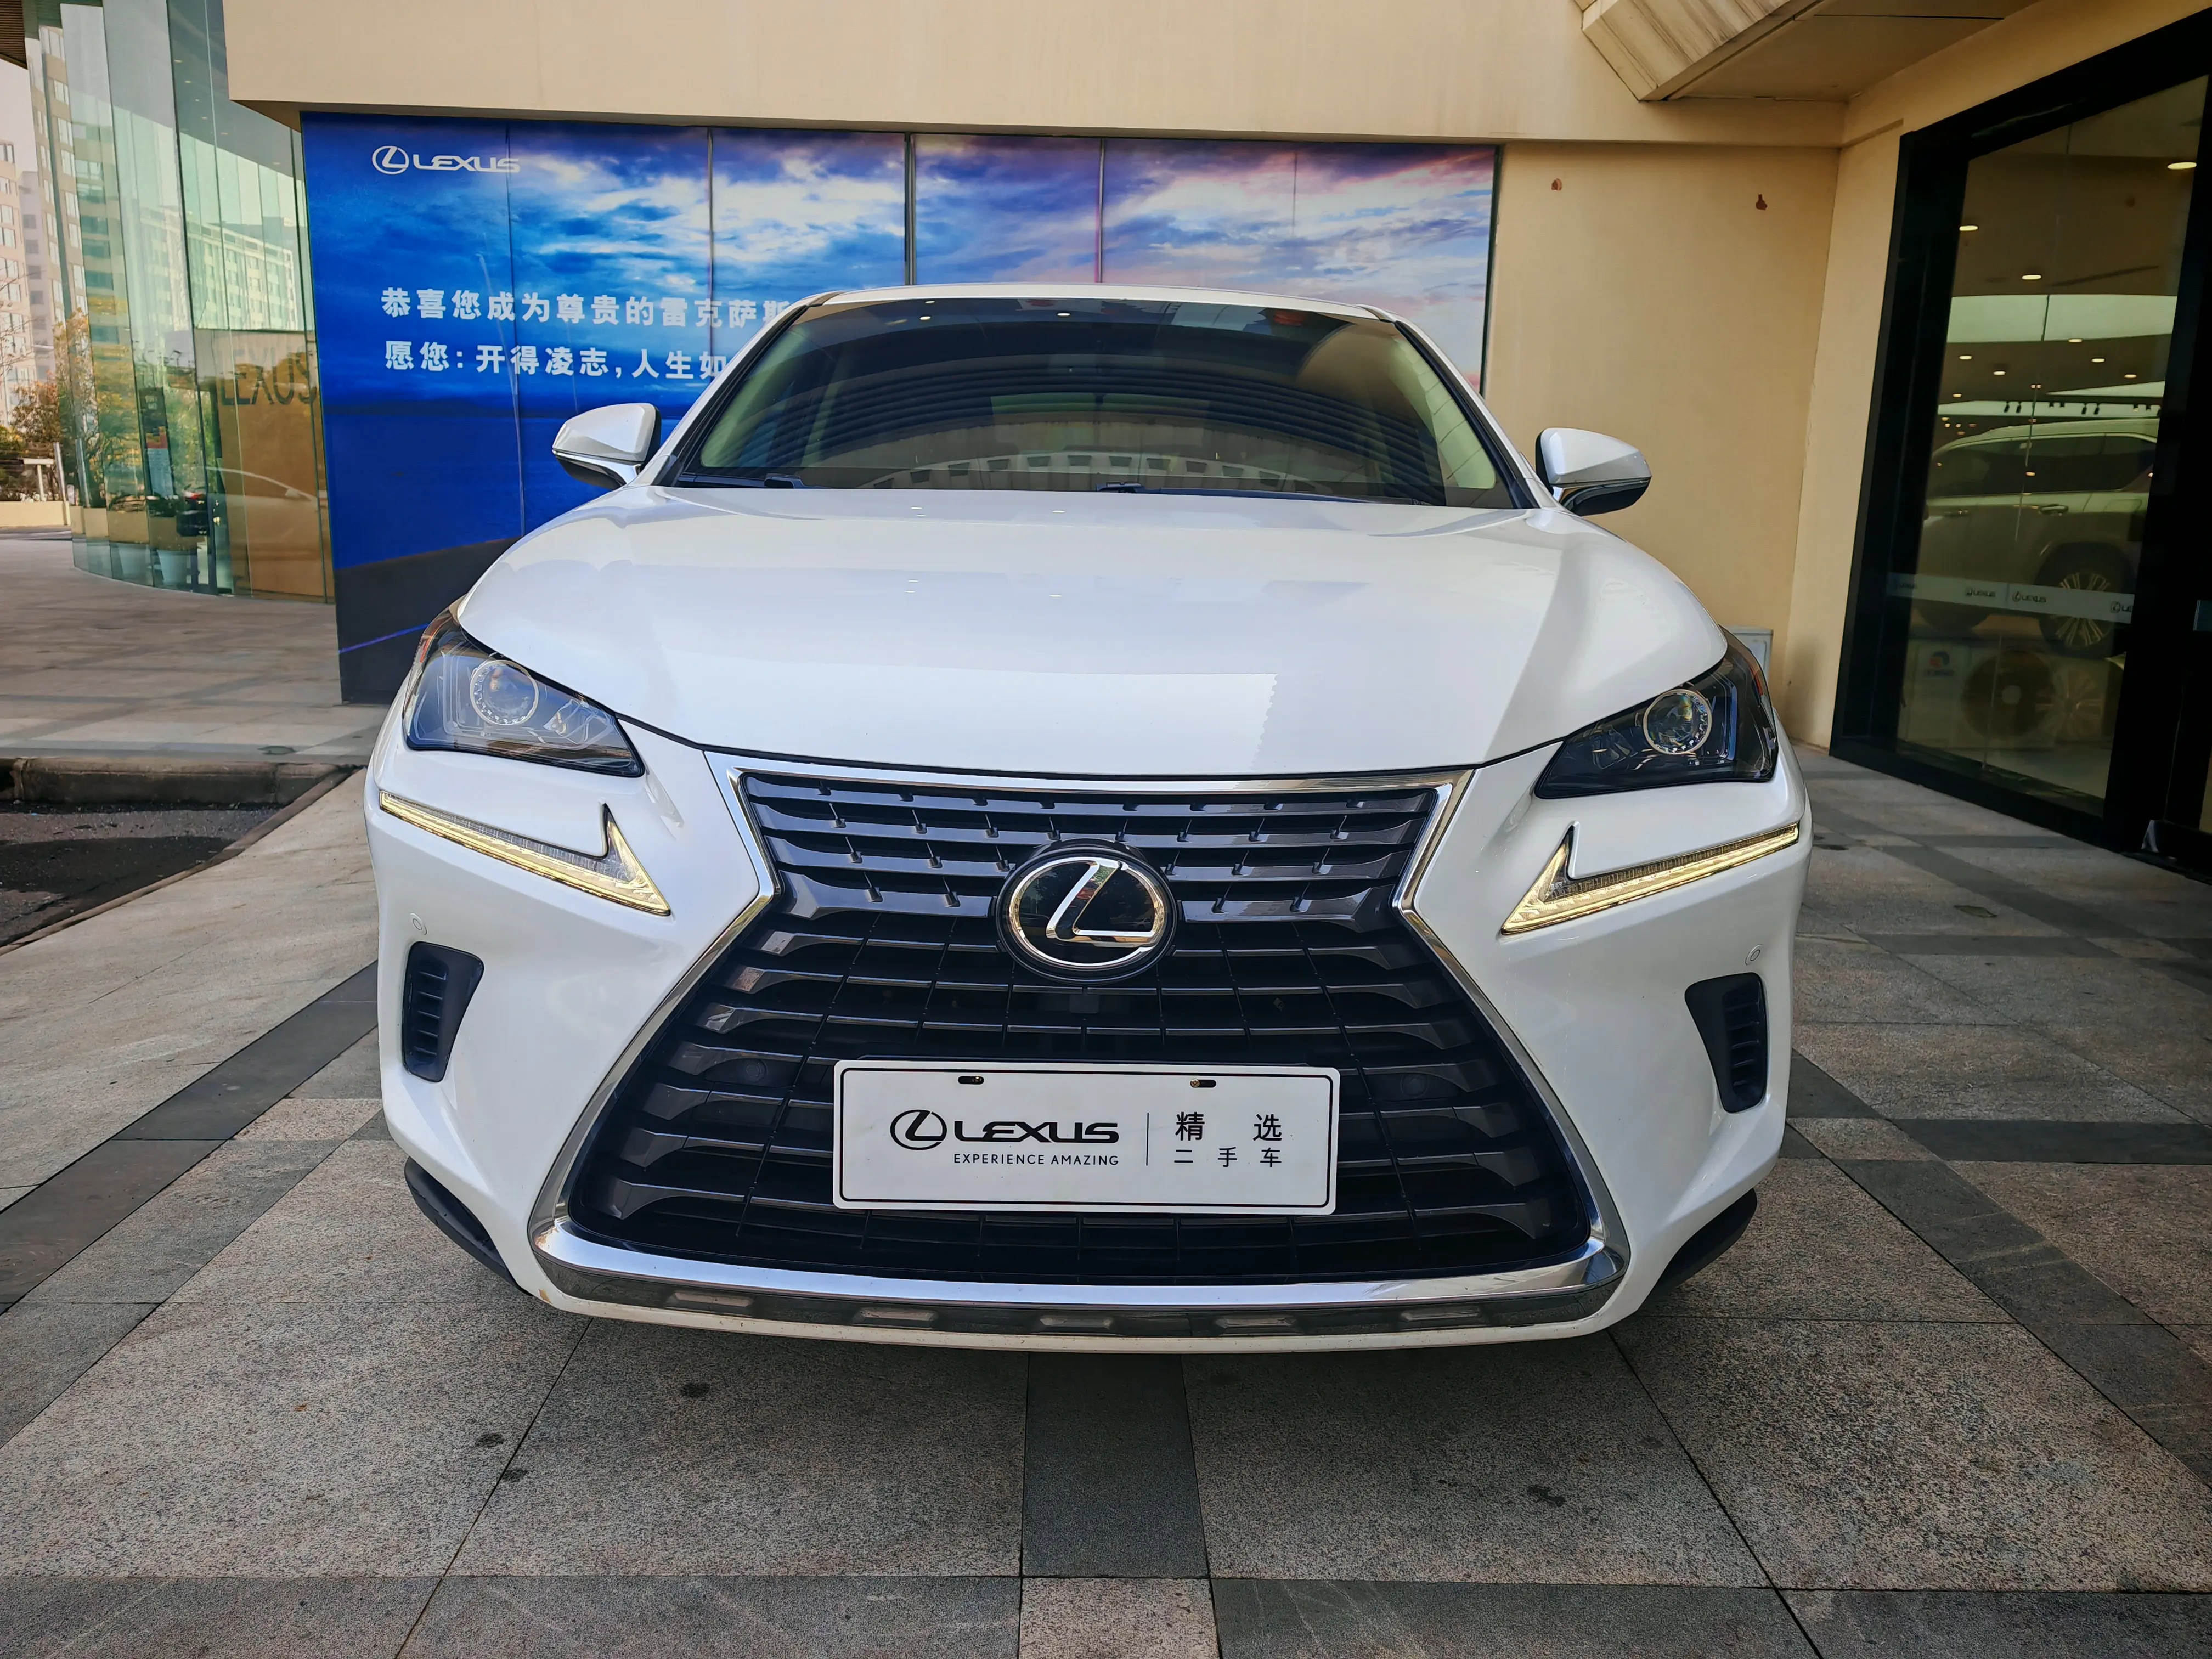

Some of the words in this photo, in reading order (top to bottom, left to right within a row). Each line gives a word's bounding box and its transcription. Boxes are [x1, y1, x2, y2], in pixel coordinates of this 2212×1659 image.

[413, 154, 521, 173] LEXUS
[221, 346, 317, 406] LEXUS
[954, 1121, 1119, 1144] LEXUS
[953, 1153, 1045, 1165] EXPERIENCE
[1051, 1154, 1119, 1166] AMAZING
[1174, 1147, 1282, 1168] 二手车
